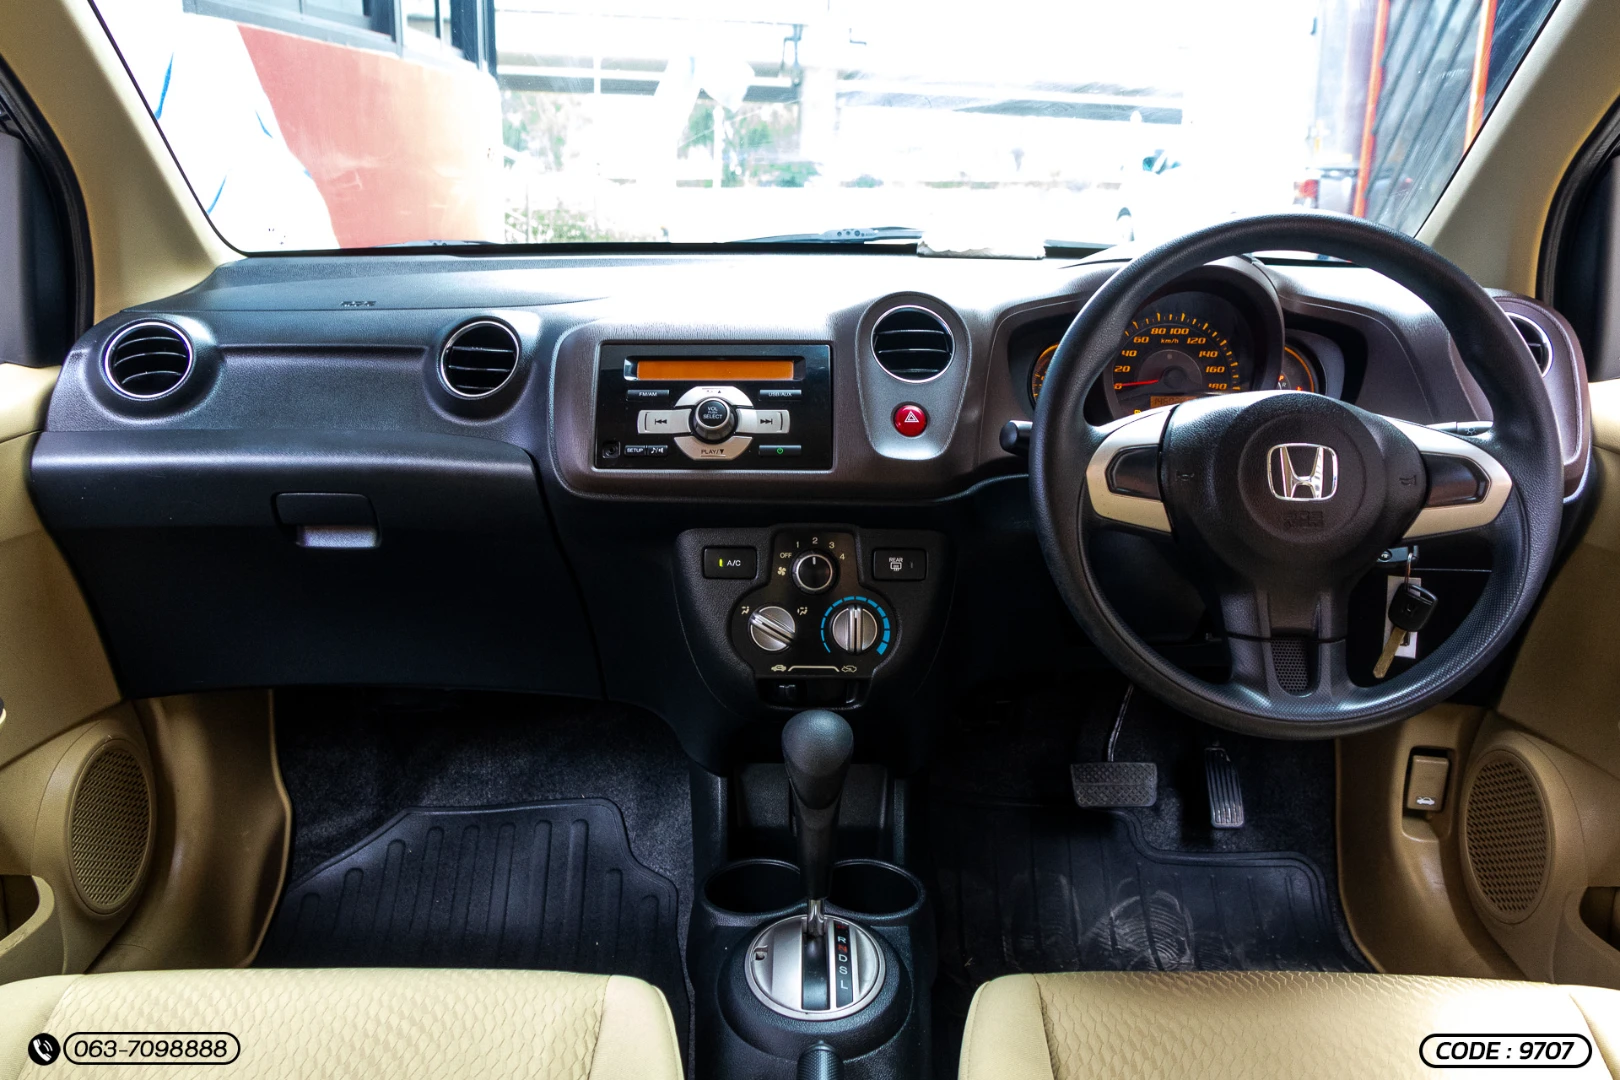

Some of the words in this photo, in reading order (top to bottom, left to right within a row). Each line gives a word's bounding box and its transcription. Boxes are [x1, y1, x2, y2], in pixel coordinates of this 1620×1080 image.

[1150, 327, 1166, 335] 80
[1169, 327, 1190, 335] 100
[1133, 336, 1149, 344] 60
[1186, 337, 1207, 345] 120
[1198, 350, 1219, 358] 140
[1114, 365, 1131, 373] 20
[812, 536, 818, 545] 2
[829, 541, 835, 549] 3
[838, 944, 847, 953] N
[838, 954, 848, 962] D
[839, 966, 848, 975] S
[840, 980, 848, 989] L
